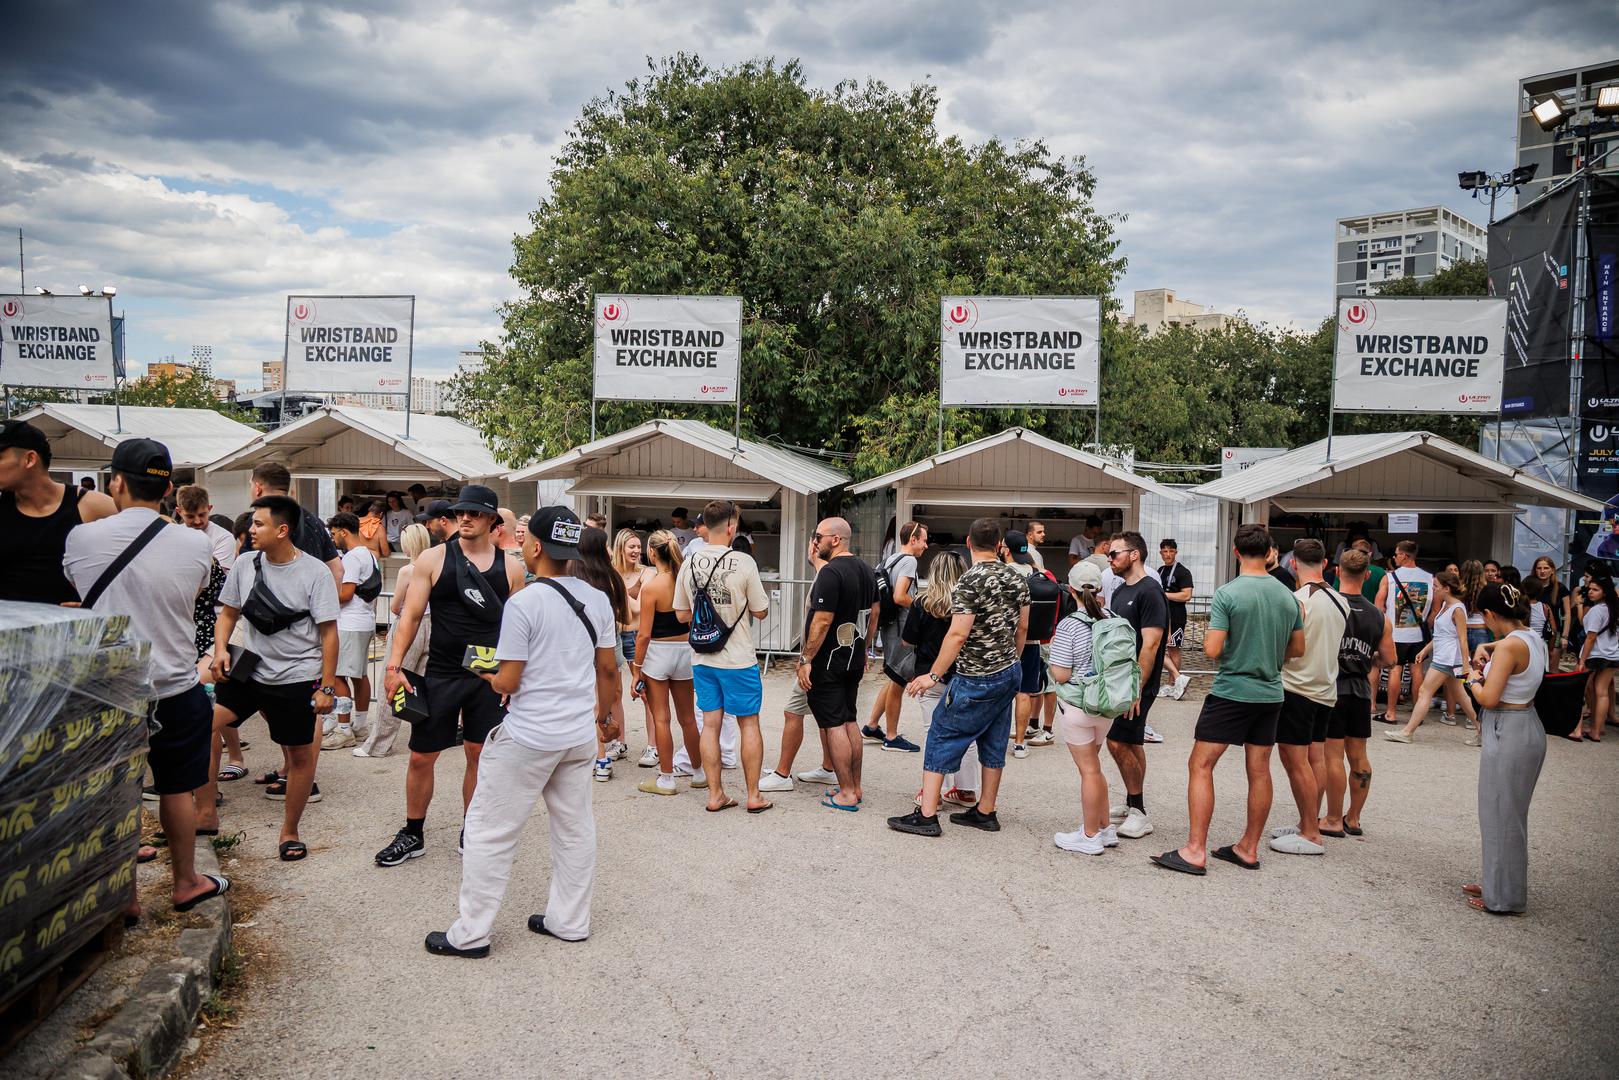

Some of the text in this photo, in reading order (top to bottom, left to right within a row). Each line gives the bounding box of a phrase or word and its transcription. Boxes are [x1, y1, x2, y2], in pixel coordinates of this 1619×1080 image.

[1601, 264, 1611, 332] MAIN ENTRANCE
[11, 325, 100, 343] WRISTBAND
[300, 327, 398, 344] WRISTBAND
[610, 328, 725, 348] WRISTBAND
[958, 331, 1083, 350] WRISTBAND
[18, 343, 97, 361] EXCHANGE
[305, 345, 393, 363] EXCHANGE
[1355, 334, 1489, 355] WRISTBAND
[616, 349, 718, 369] EXCHANGE
[964, 352, 1076, 370] EXCHANGE
[1360, 357, 1480, 378] EXCHANGE
